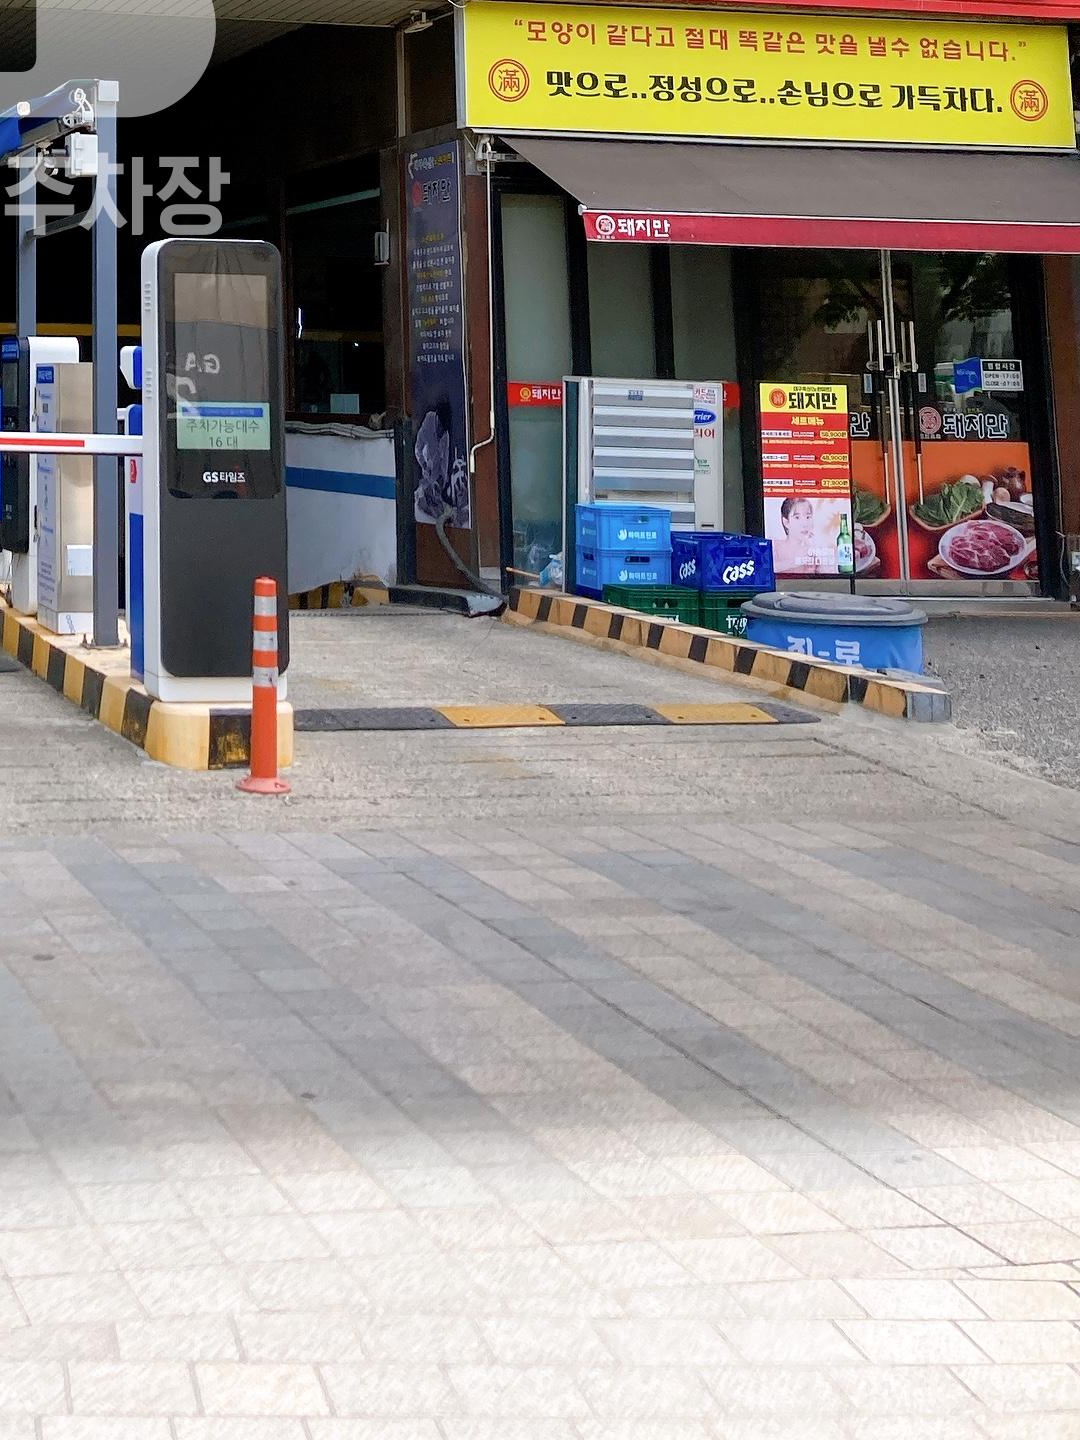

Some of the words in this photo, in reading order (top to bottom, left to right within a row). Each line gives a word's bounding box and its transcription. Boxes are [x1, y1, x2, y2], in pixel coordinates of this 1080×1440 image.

[606, 23, 676, 48] 같다고
[684, 27, 729, 51] 절대
[738, 29, 806, 55] 똑같은
[815, 32, 859, 57] 맛을
[867, 35, 910, 59] 낼수
[497, 67, 521, 93] 滿
[890, 83, 1004, 114] 가득차다.
[1019, 89, 1040, 113] 滿
[617, 217, 671, 238] 돼지만
[531, 388, 562, 400] 돼지만
[788, 391, 838, 410] 돼지만
[942, 413, 1009, 439] 돼지만
